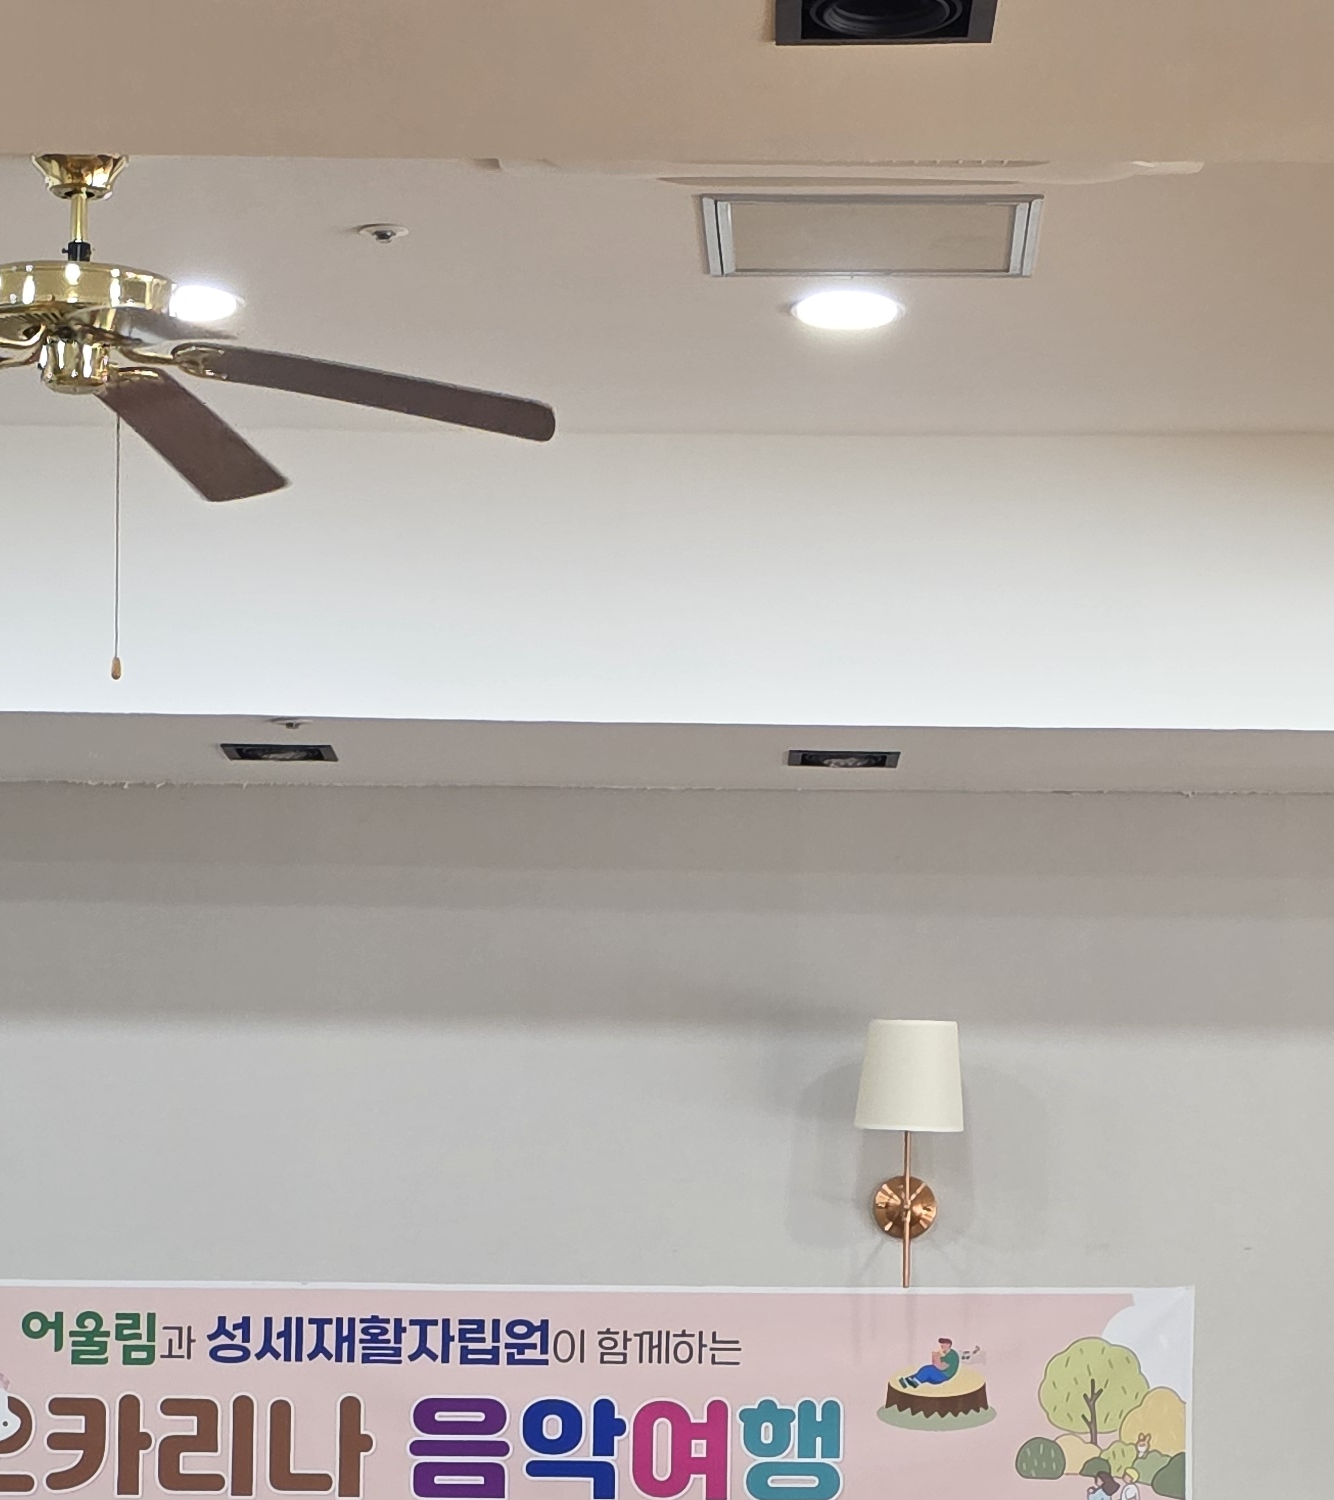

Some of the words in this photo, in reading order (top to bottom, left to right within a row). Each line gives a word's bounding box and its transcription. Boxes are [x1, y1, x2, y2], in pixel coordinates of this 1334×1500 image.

[21, 1310, 197, 1366] 어울림과
[206, 1314, 585, 1367] 성세재활자립원이
[597, 1327, 742, 1366] 함께하는
